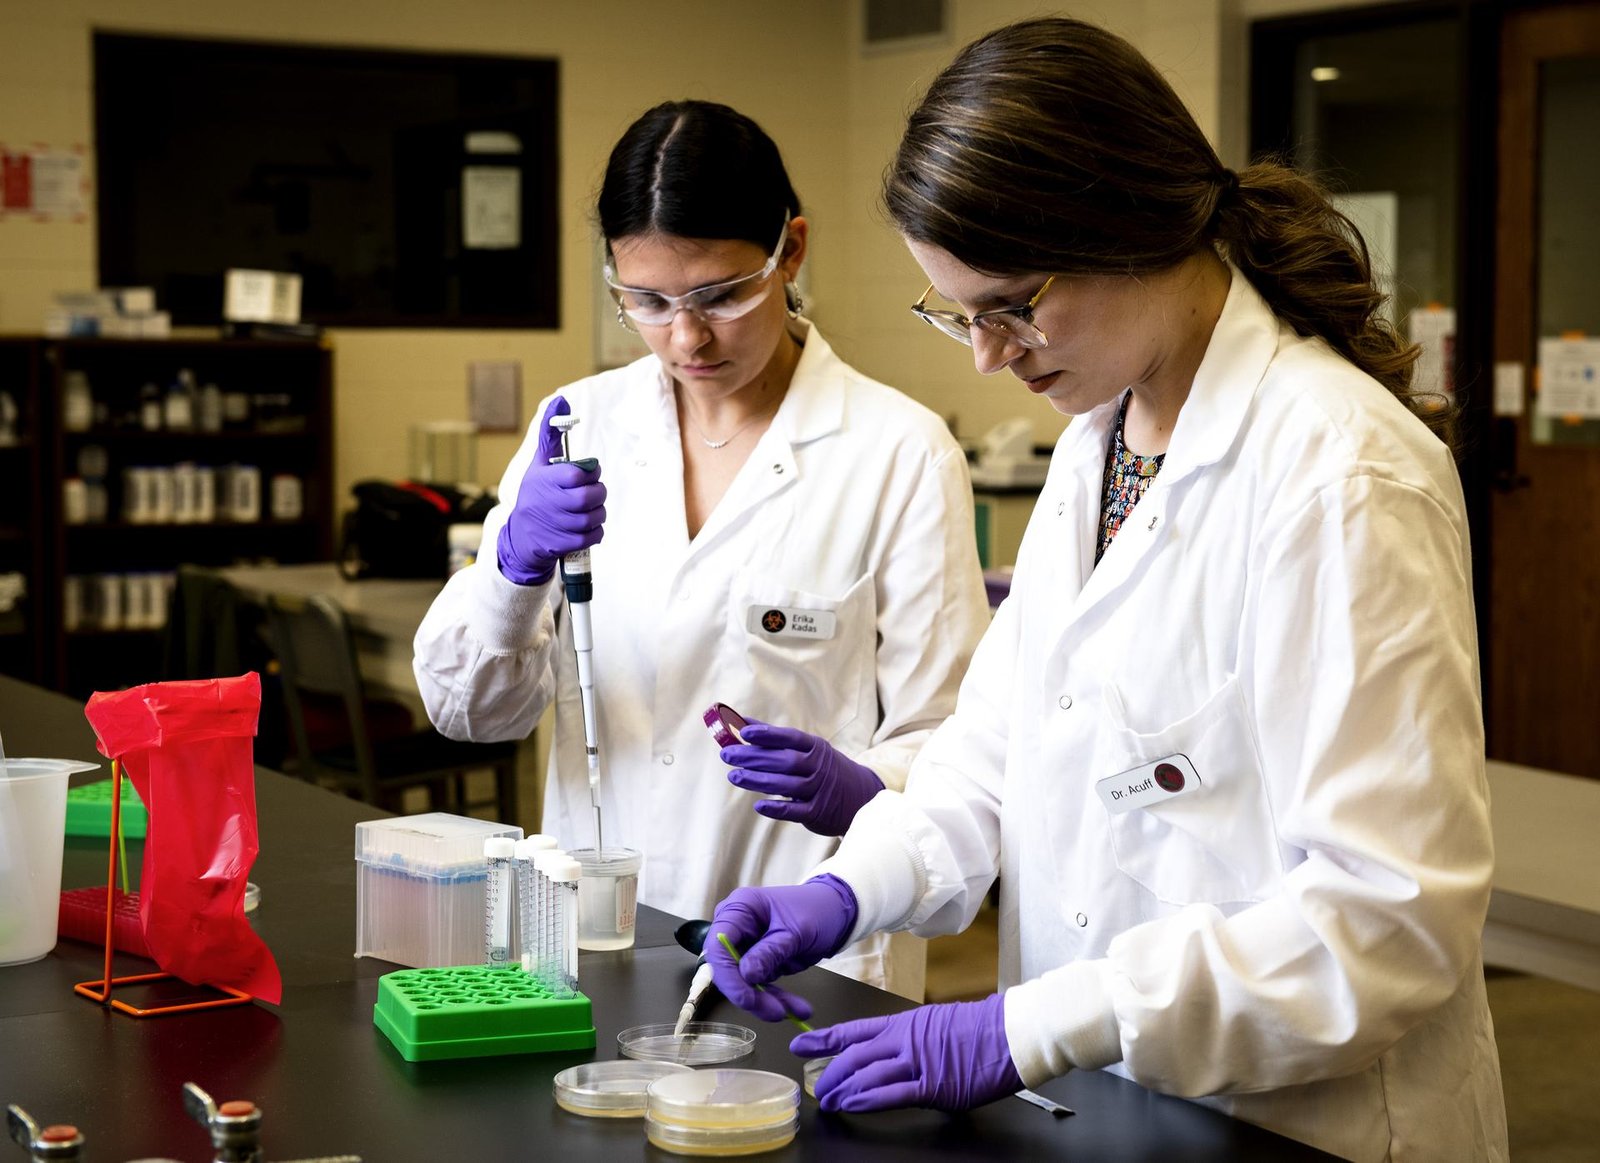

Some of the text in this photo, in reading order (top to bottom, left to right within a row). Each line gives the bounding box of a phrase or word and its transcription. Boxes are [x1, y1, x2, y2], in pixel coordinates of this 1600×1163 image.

[792, 614, 814, 623] Erika
[792, 623, 817, 633] Kadas
[1111, 778, 1153, 800] Dr. Acuff
